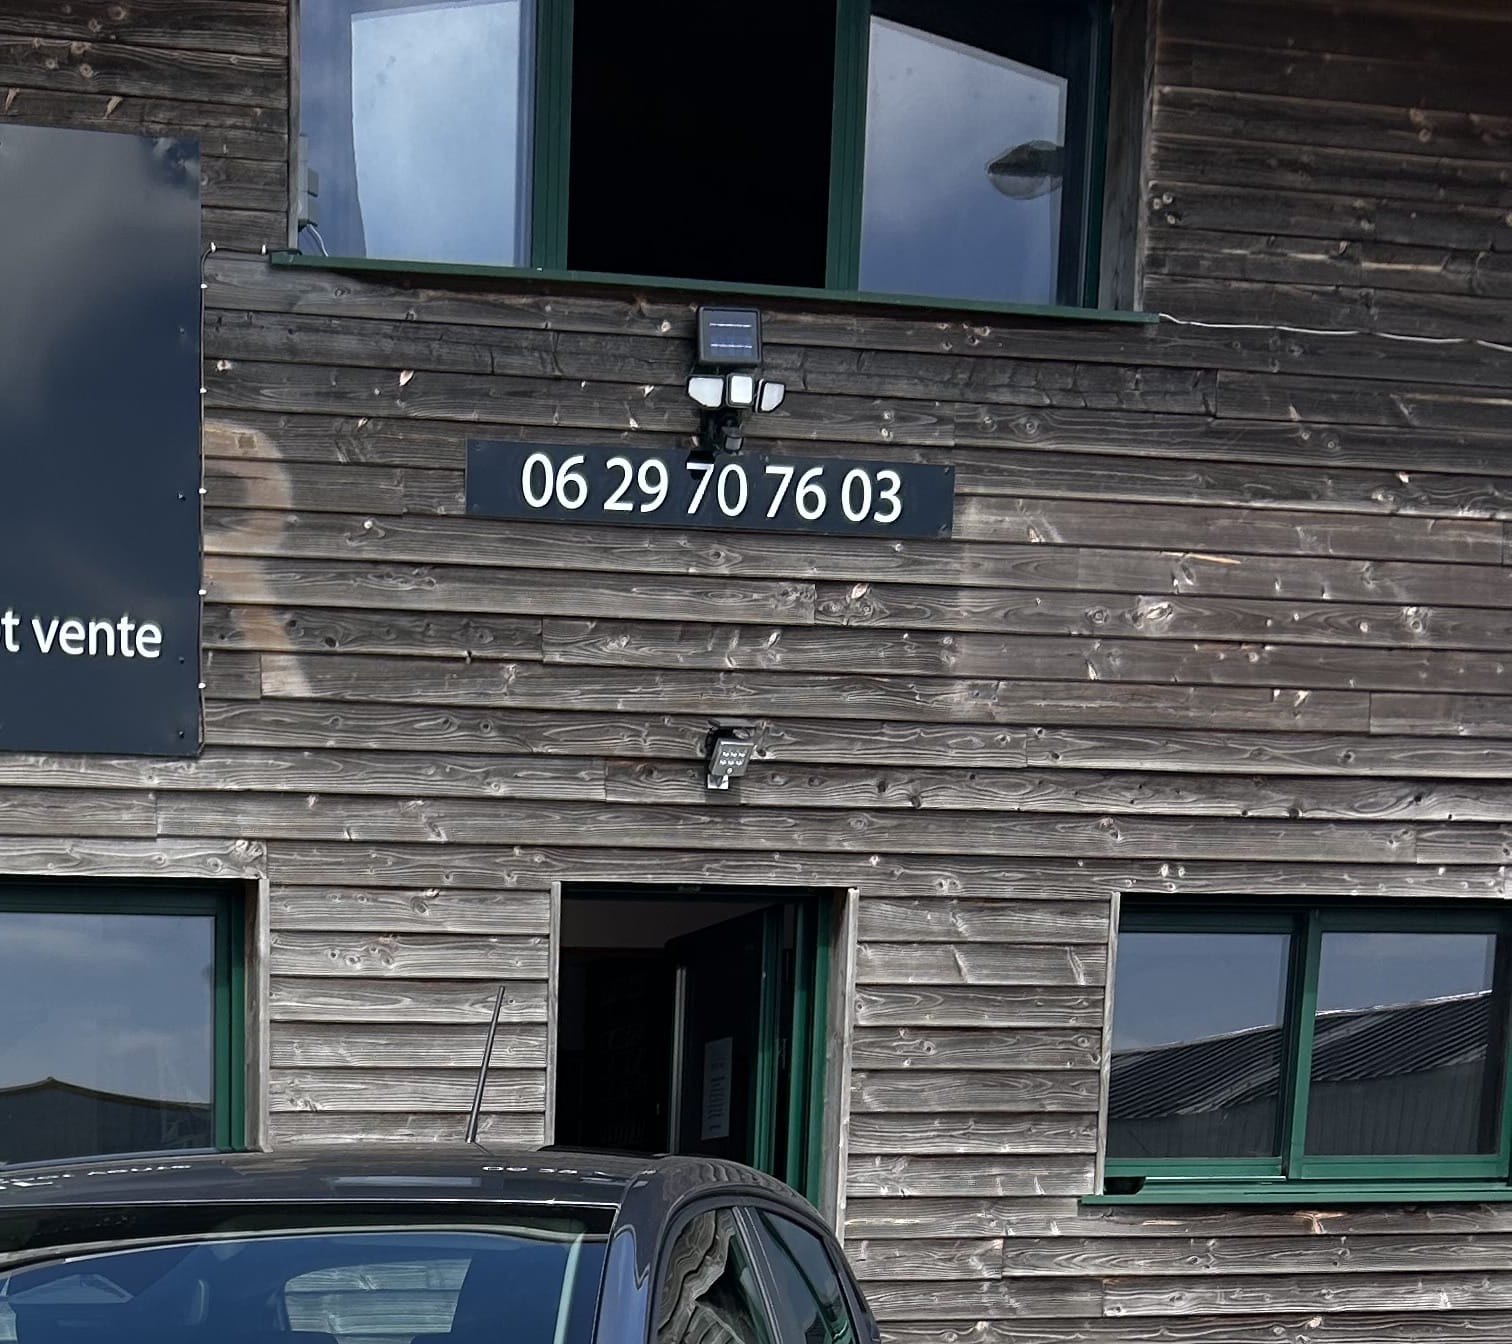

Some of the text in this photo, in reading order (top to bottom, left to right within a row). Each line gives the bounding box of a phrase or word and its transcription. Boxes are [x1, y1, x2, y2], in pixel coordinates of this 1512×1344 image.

[522, 453, 902, 523] 06 29 70 76 03
[31, 618, 162, 658] vente
